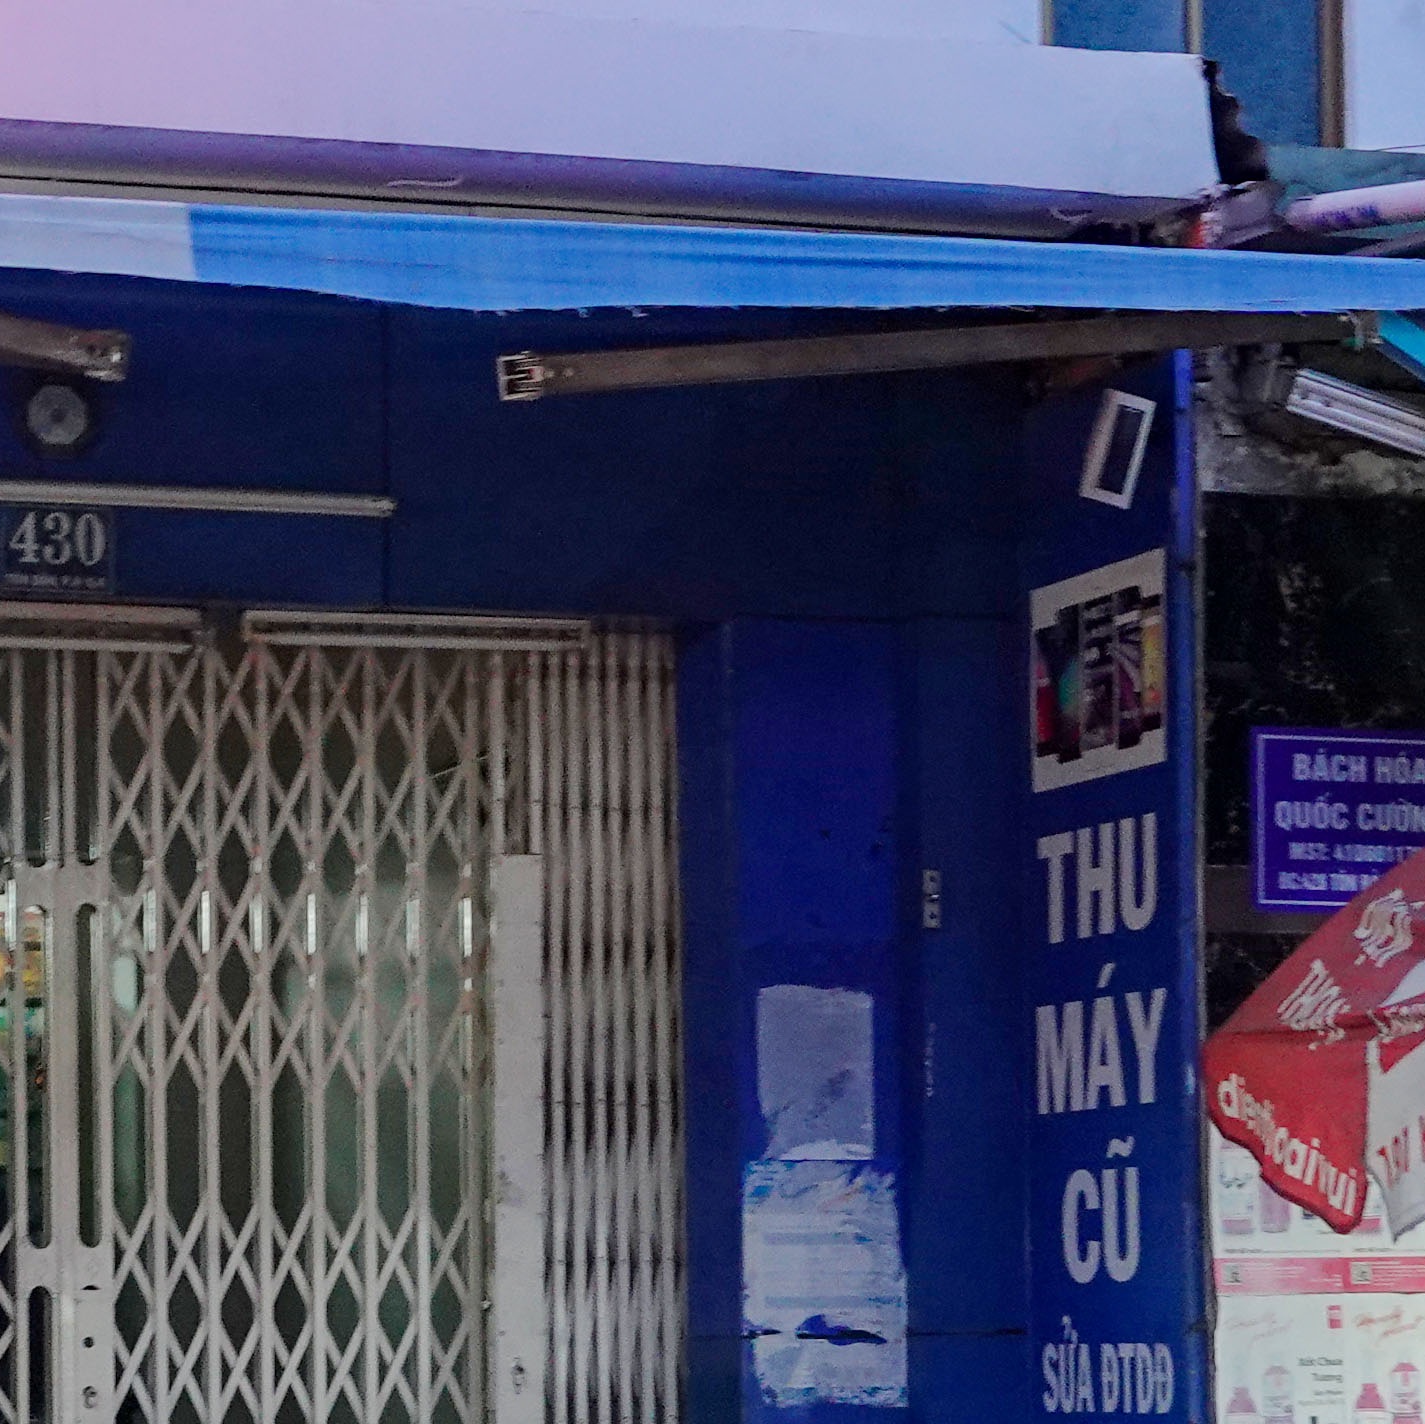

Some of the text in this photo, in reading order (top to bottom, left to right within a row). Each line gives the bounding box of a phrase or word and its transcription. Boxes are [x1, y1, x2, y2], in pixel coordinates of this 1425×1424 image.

[9, 511, 106, 566] 430
[1274, 792, 1351, 832] QUỐC
[1292, 748, 1368, 782] BÁCH
[1037, 812, 1158, 944] THU
[1035, 962, 1168, 1116] MÁY
[1062, 1135, 1141, 1284] CŨ
[1042, 1315, 1174, 1415] SỬA ĐTDĐ
